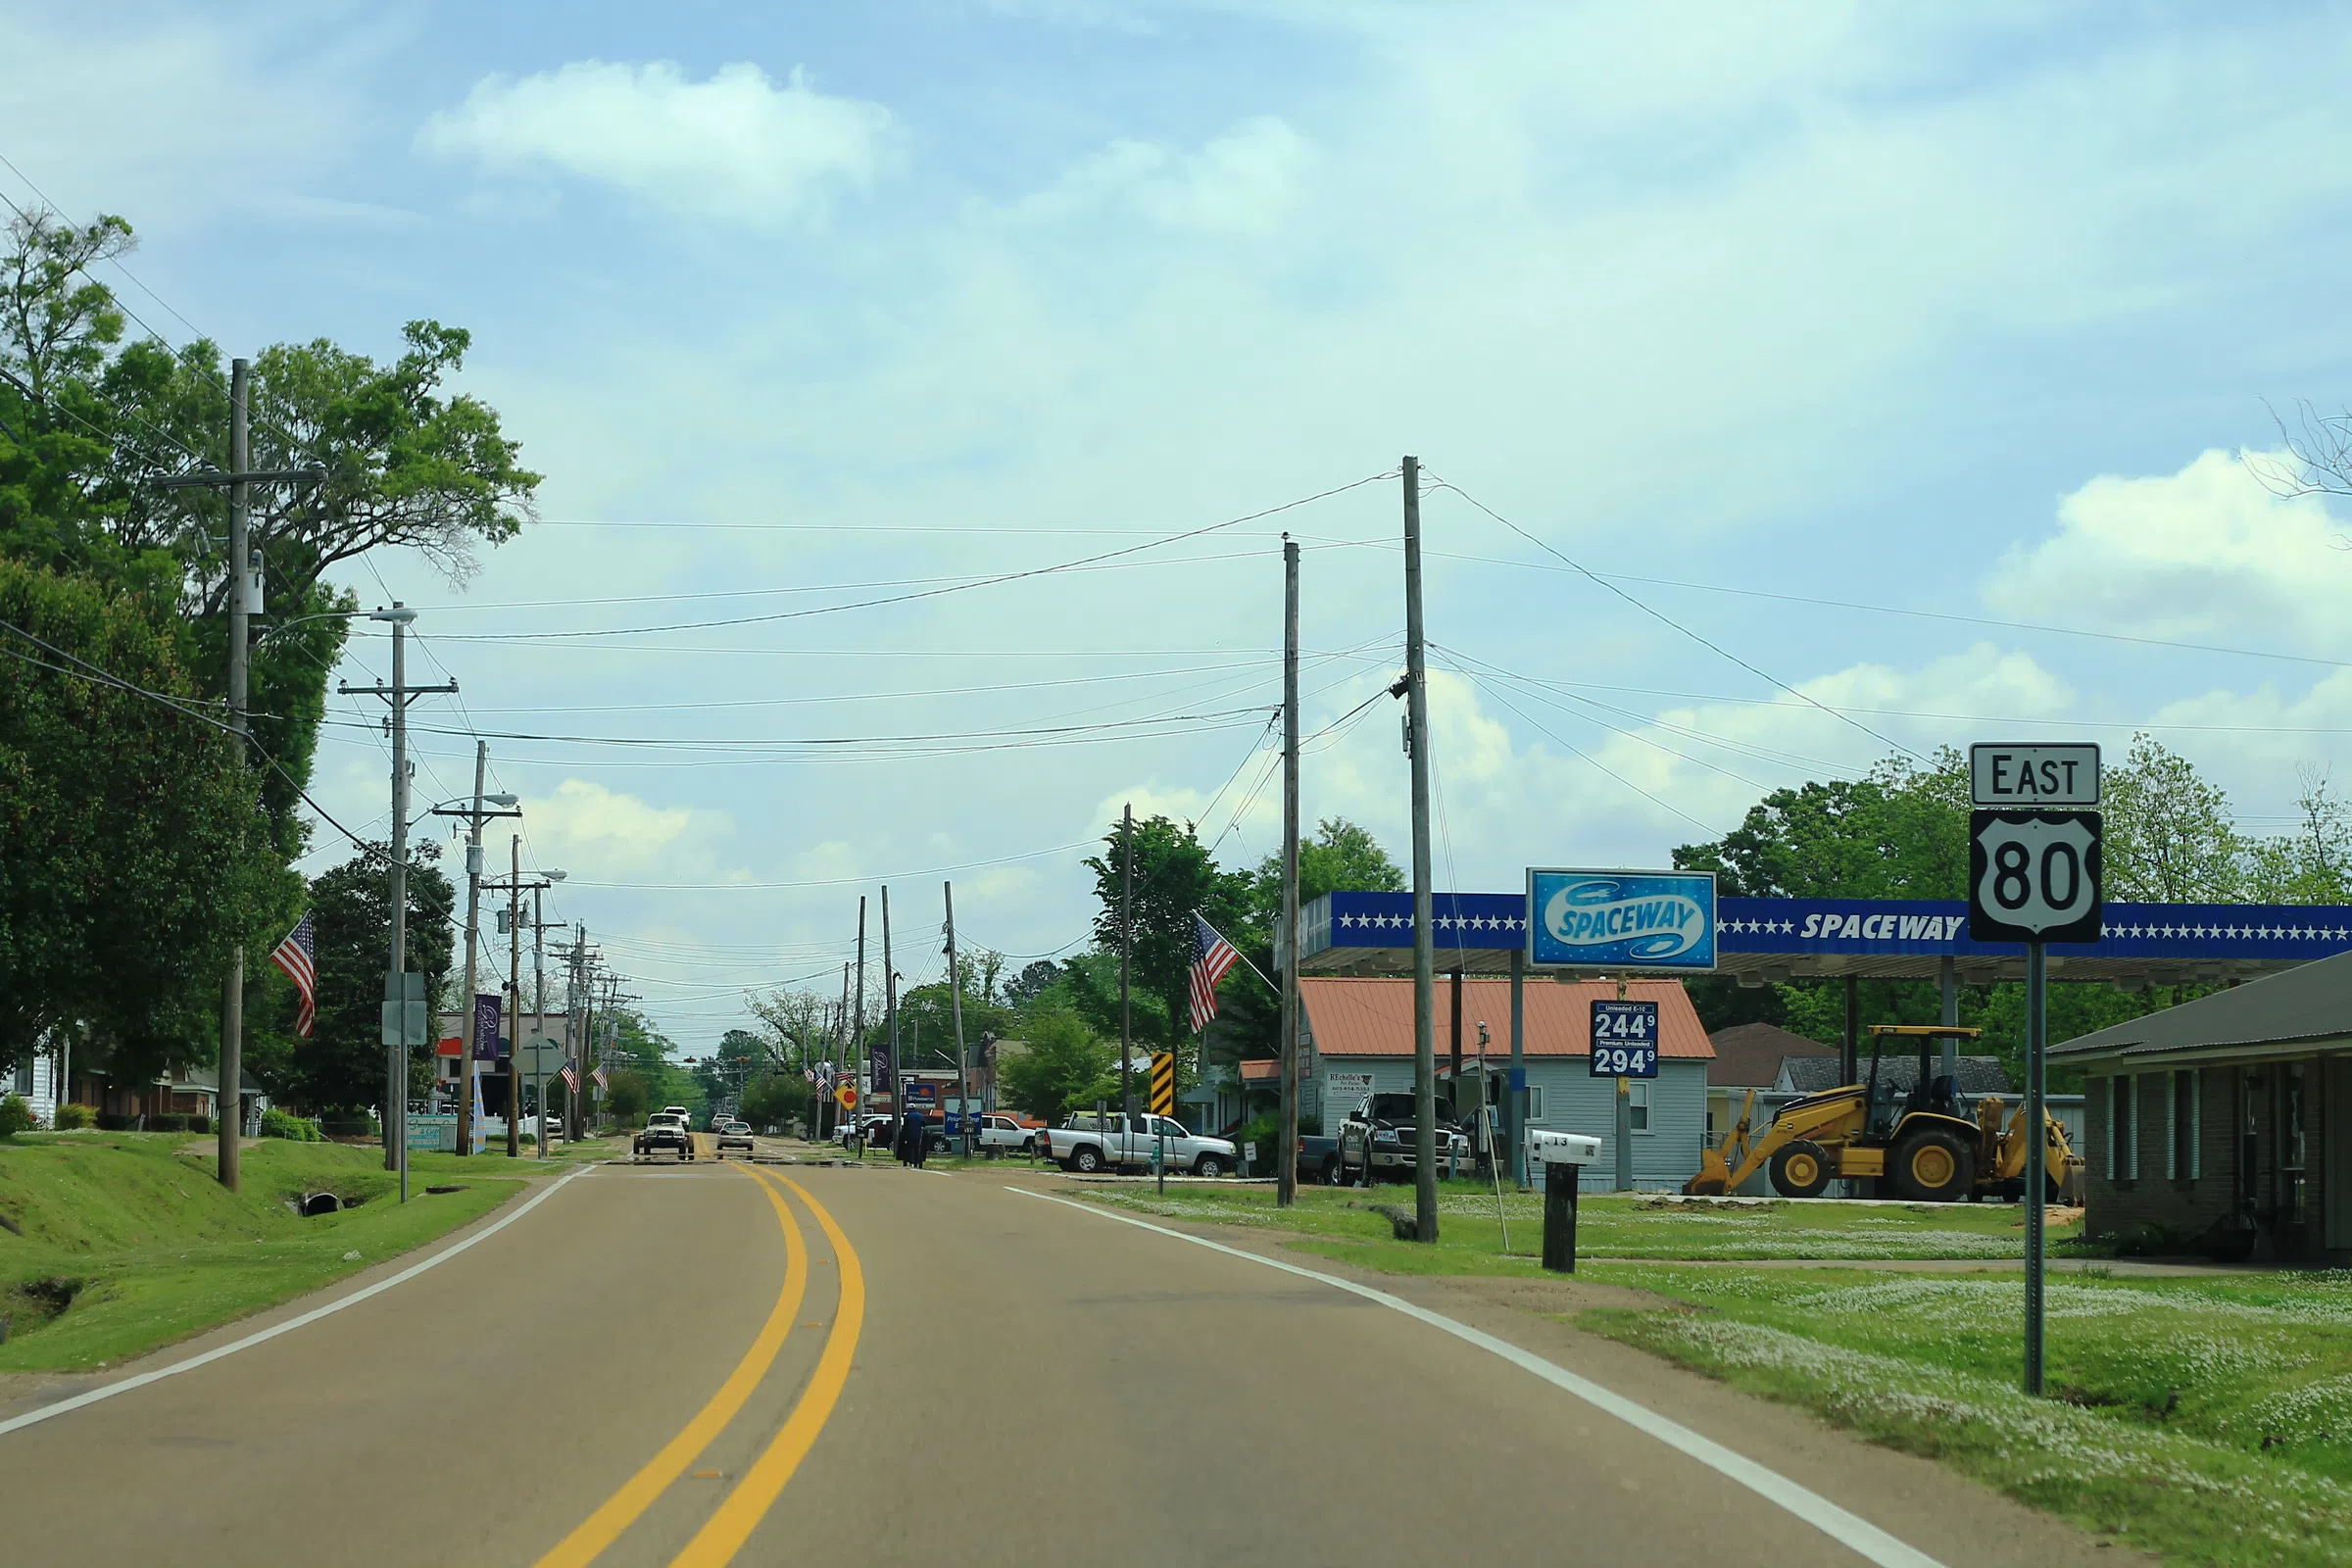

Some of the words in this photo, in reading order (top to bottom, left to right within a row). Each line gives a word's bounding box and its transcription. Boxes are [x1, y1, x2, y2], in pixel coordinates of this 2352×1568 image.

[1992, 755, 2079, 795] EAST
[1993, 841, 2080, 910] 80
[1557, 901, 1695, 939] SPACEWAY
[1799, 913, 1966, 941] SPACEWAY
[1553, 1137, 1568, 1147] 13
